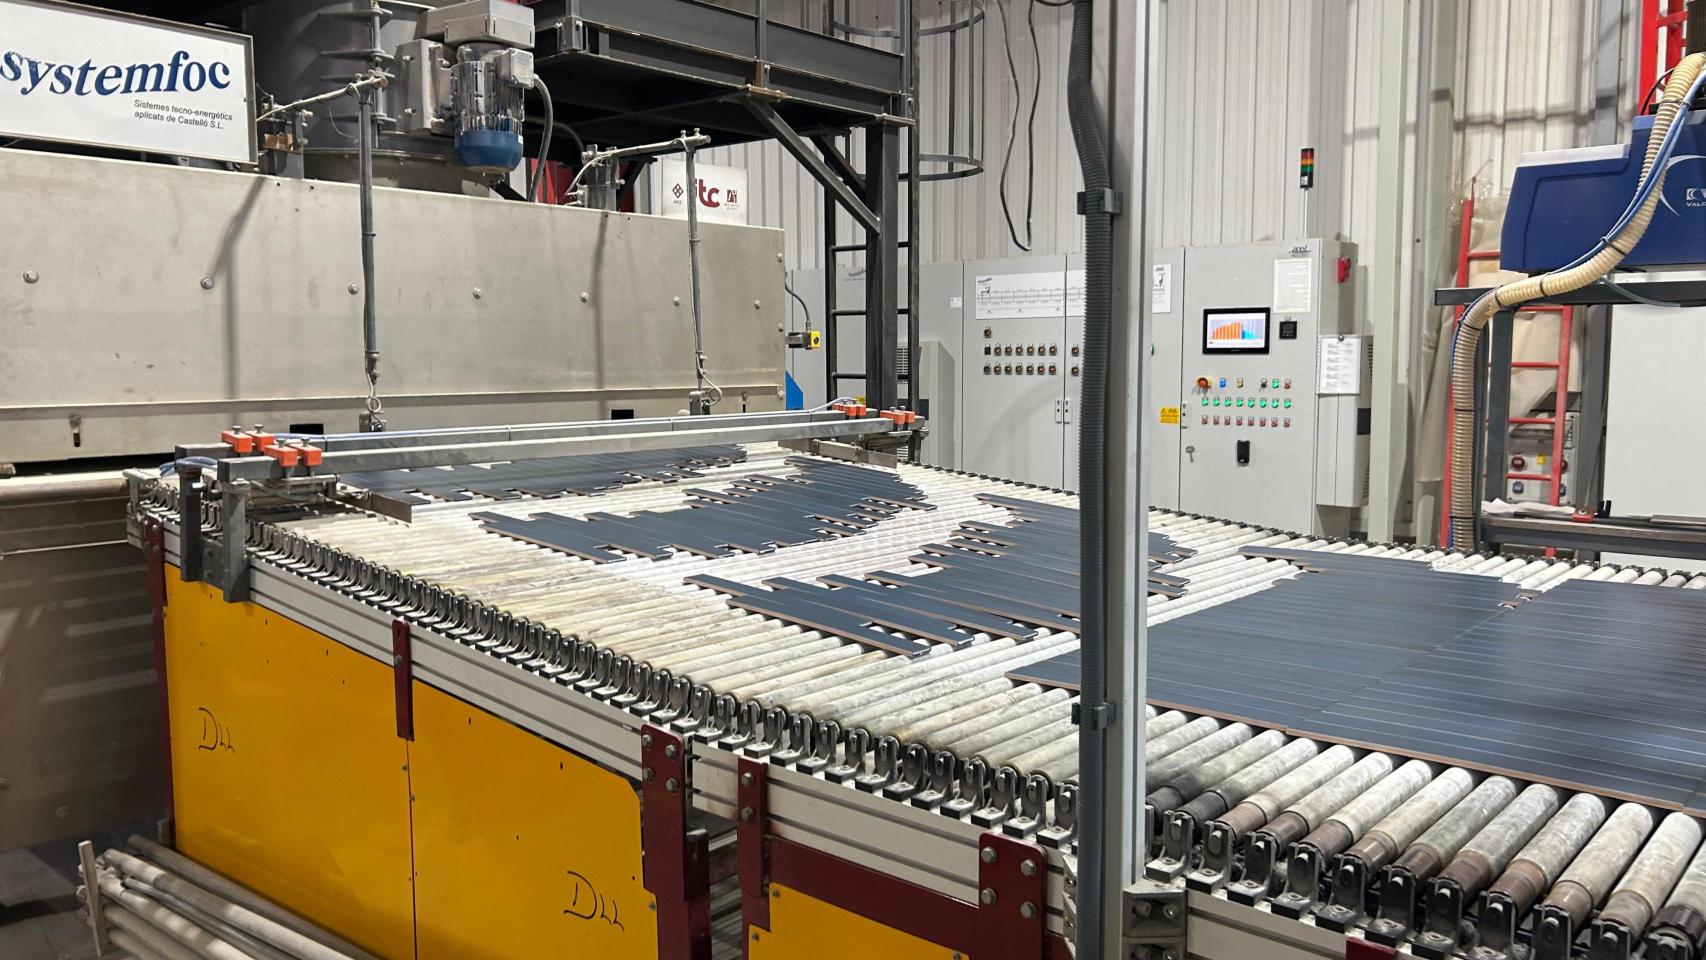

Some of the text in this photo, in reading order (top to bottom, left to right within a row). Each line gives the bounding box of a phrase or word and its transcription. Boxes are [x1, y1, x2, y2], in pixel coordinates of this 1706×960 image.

[0, 50, 231, 96] systemfoc
[134, 99, 233, 121] Sistemes tecno-energétics
[134, 110, 225, 129] aplicats de Castelló S.L.
